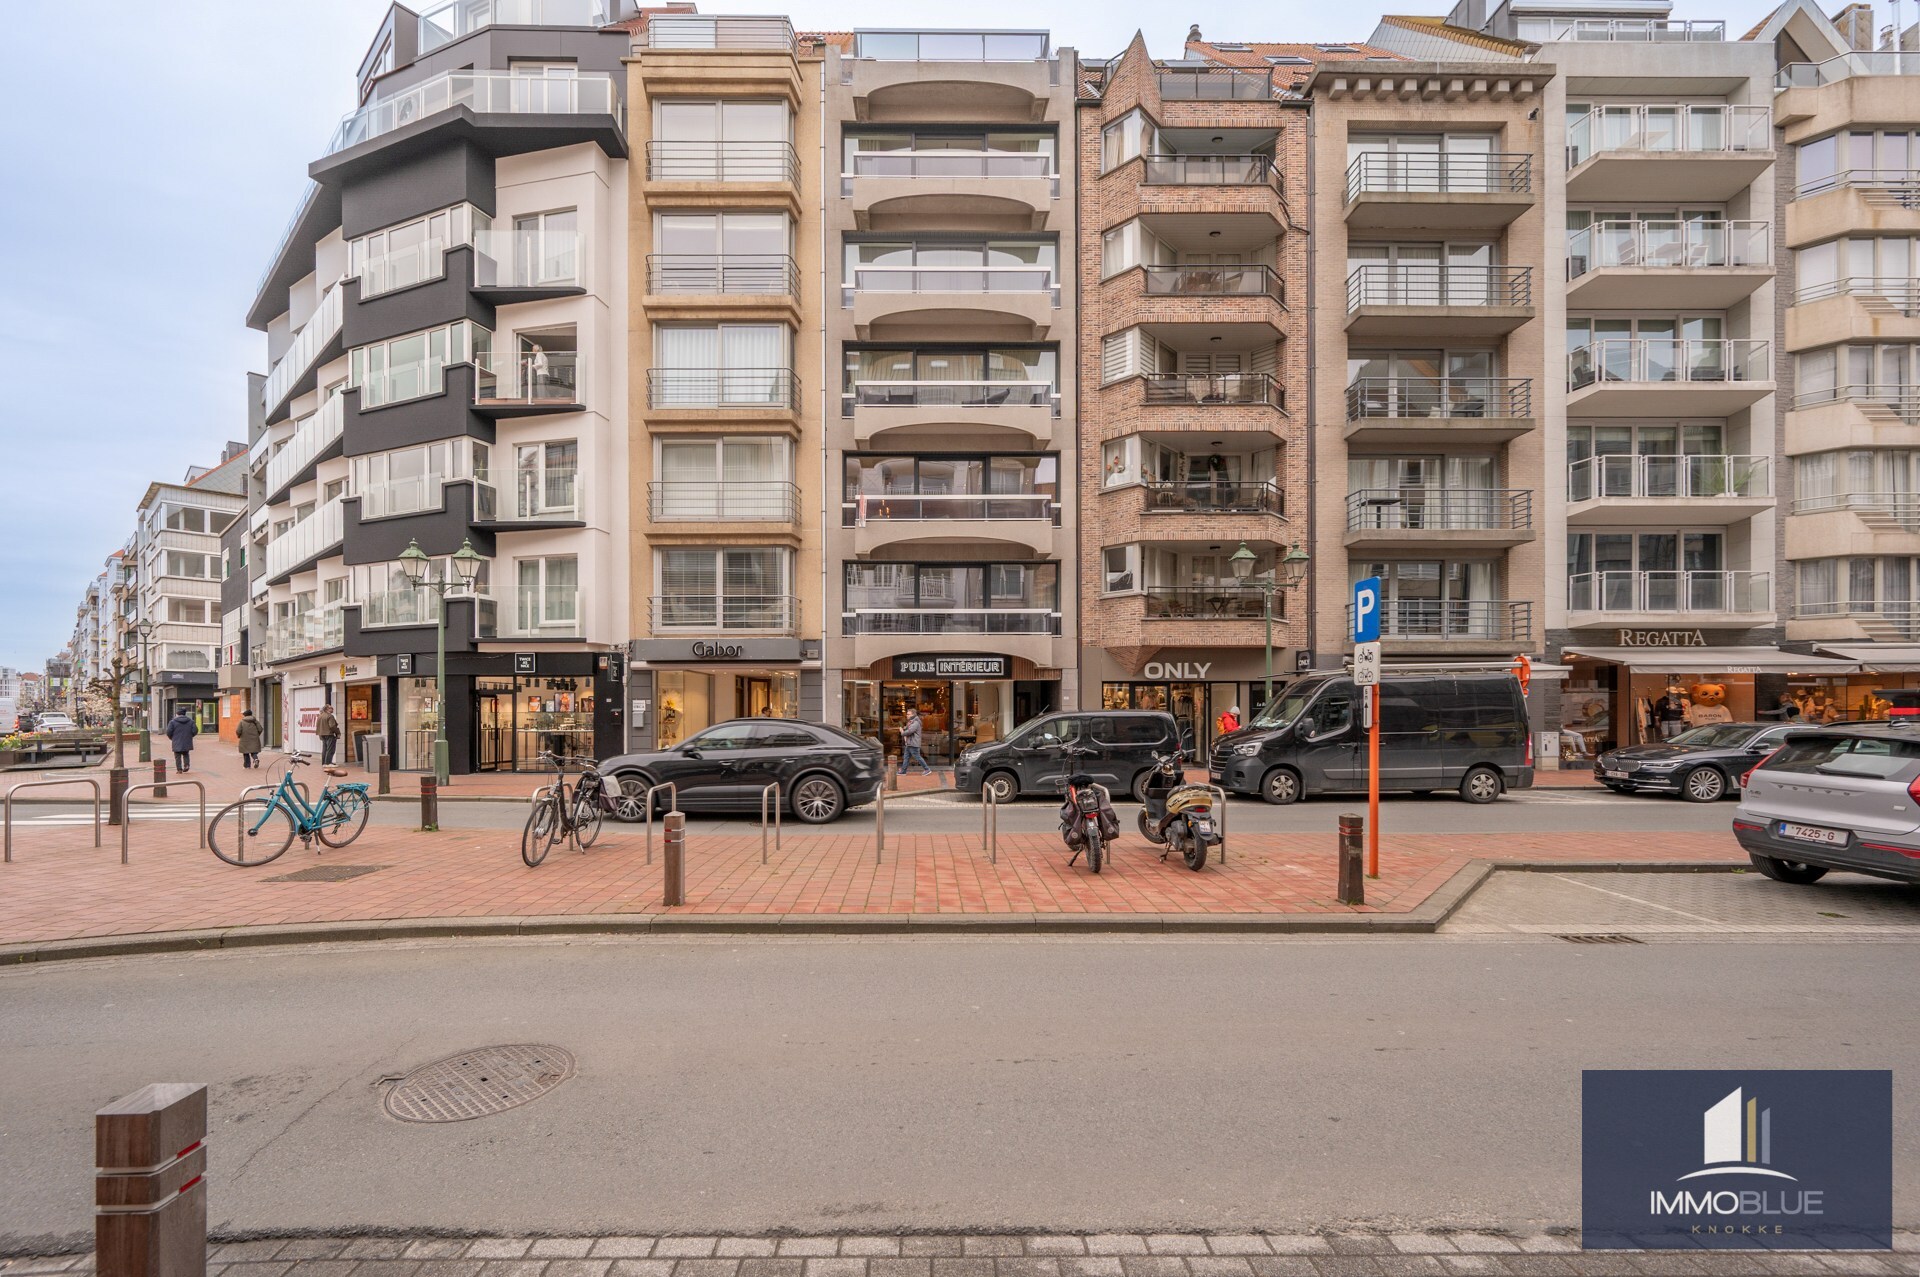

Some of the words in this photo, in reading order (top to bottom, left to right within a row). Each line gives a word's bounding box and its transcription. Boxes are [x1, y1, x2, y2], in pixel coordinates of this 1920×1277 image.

[1357, 588, 1375, 633] P
[1618, 628, 1707, 647] REGATTA
[692, 641, 743, 658] Gabor
[900, 661, 935, 673] PURE
[939, 660, 1001, 673] INTÉRIEUR
[1144, 661, 1212, 680] ONLY
[1727, 665, 1763, 674] REGATTA
